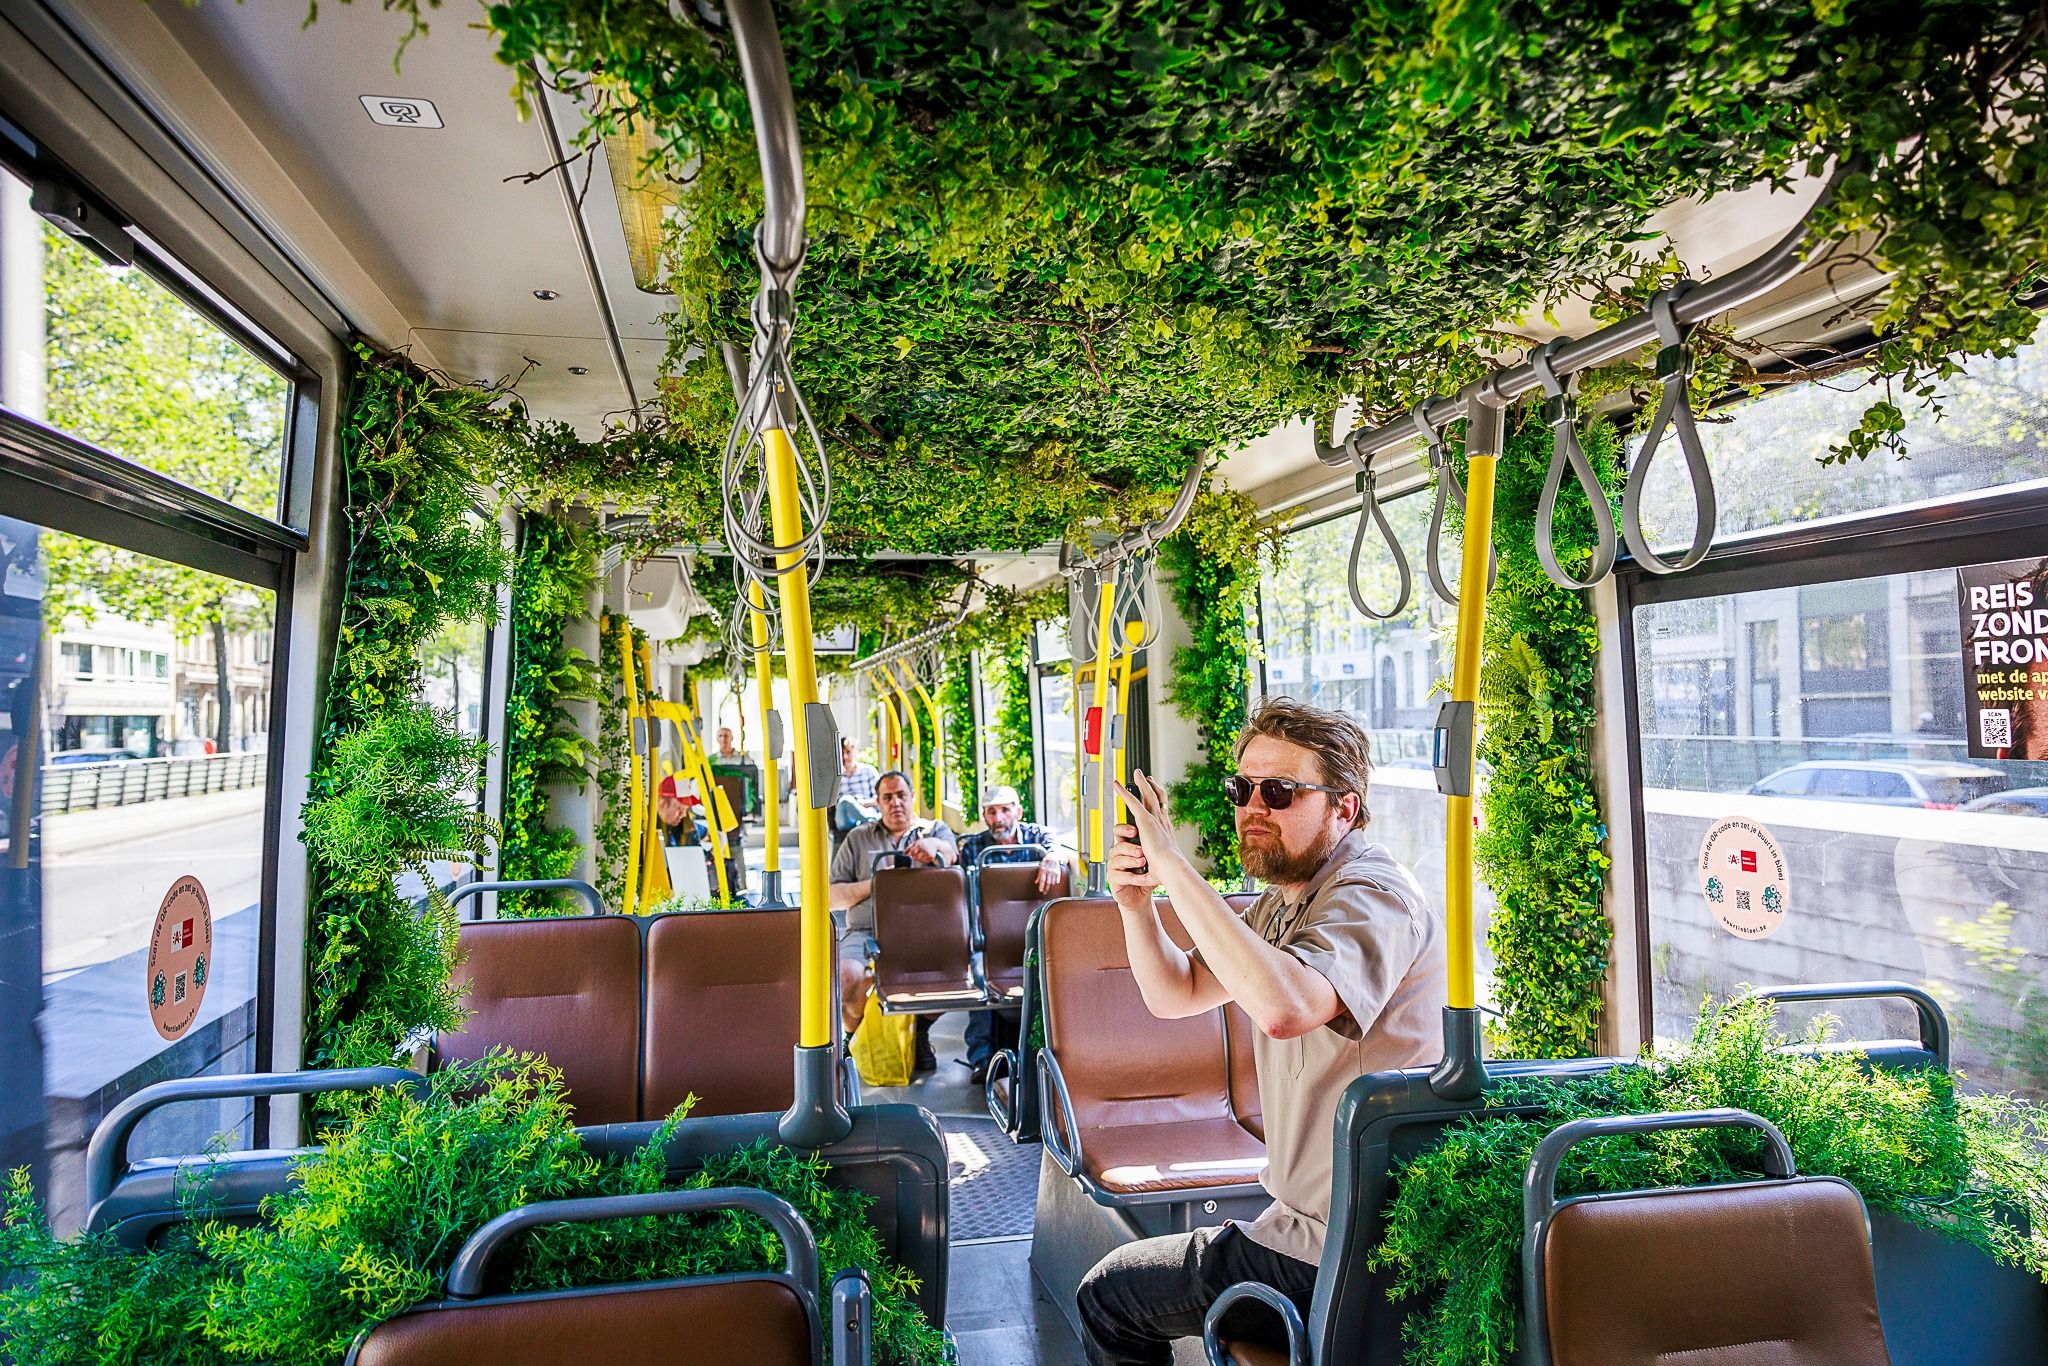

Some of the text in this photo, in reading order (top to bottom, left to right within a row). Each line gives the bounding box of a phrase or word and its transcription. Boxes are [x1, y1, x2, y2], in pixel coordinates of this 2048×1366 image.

[1970, 582, 2034, 610] REIS
[1971, 609, 2048, 638] ZOND
[1977, 671, 2005, 685] met
[2009, 669, 2028, 683] de
[1977, 687, 2048, 701] website v
[1702, 851, 1710, 870] Scan
[1706, 841, 1713, 851] de
[1710, 822, 1731, 842] QR-code
[1740, 822, 1750, 830] zet
[1750, 824, 1757, 834] je
[1757, 830, 1773, 850] buurt
[1771, 849, 1778, 859] in
[157, 924, 162, 937] de
[160, 890, 178, 922] QR-code
[179, 885, 185, 894] en
